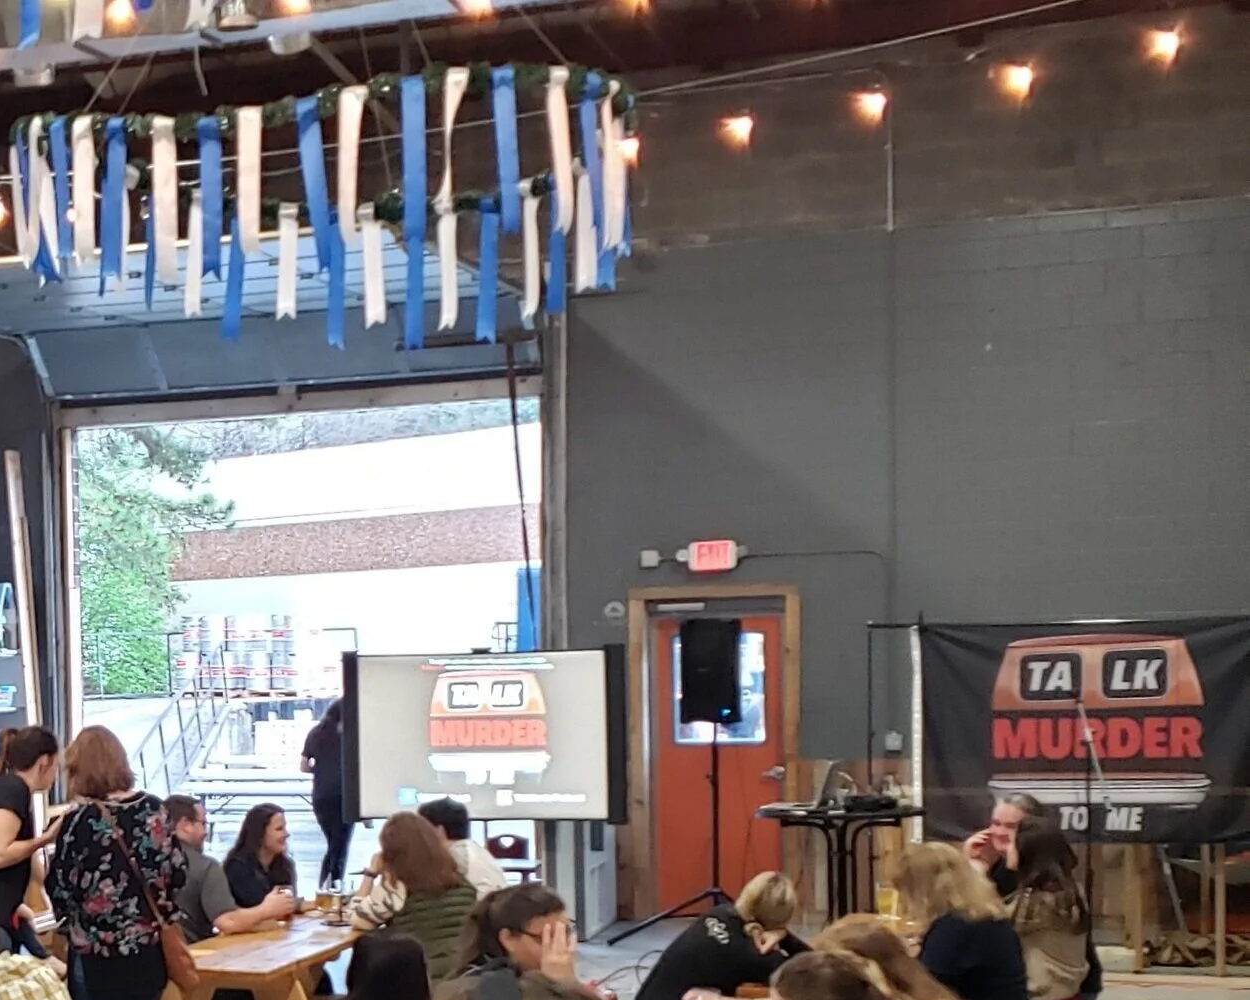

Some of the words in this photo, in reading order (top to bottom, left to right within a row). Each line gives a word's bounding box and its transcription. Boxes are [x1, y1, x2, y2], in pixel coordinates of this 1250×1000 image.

[1027, 660, 1073, 692] TA
[1109, 658, 1164, 691] LK
[430, 718, 548, 747] MURDER
[992, 716, 1204, 760] MURDER
[1059, 806, 1090, 831] TO
[1105, 806, 1144, 831] ME
